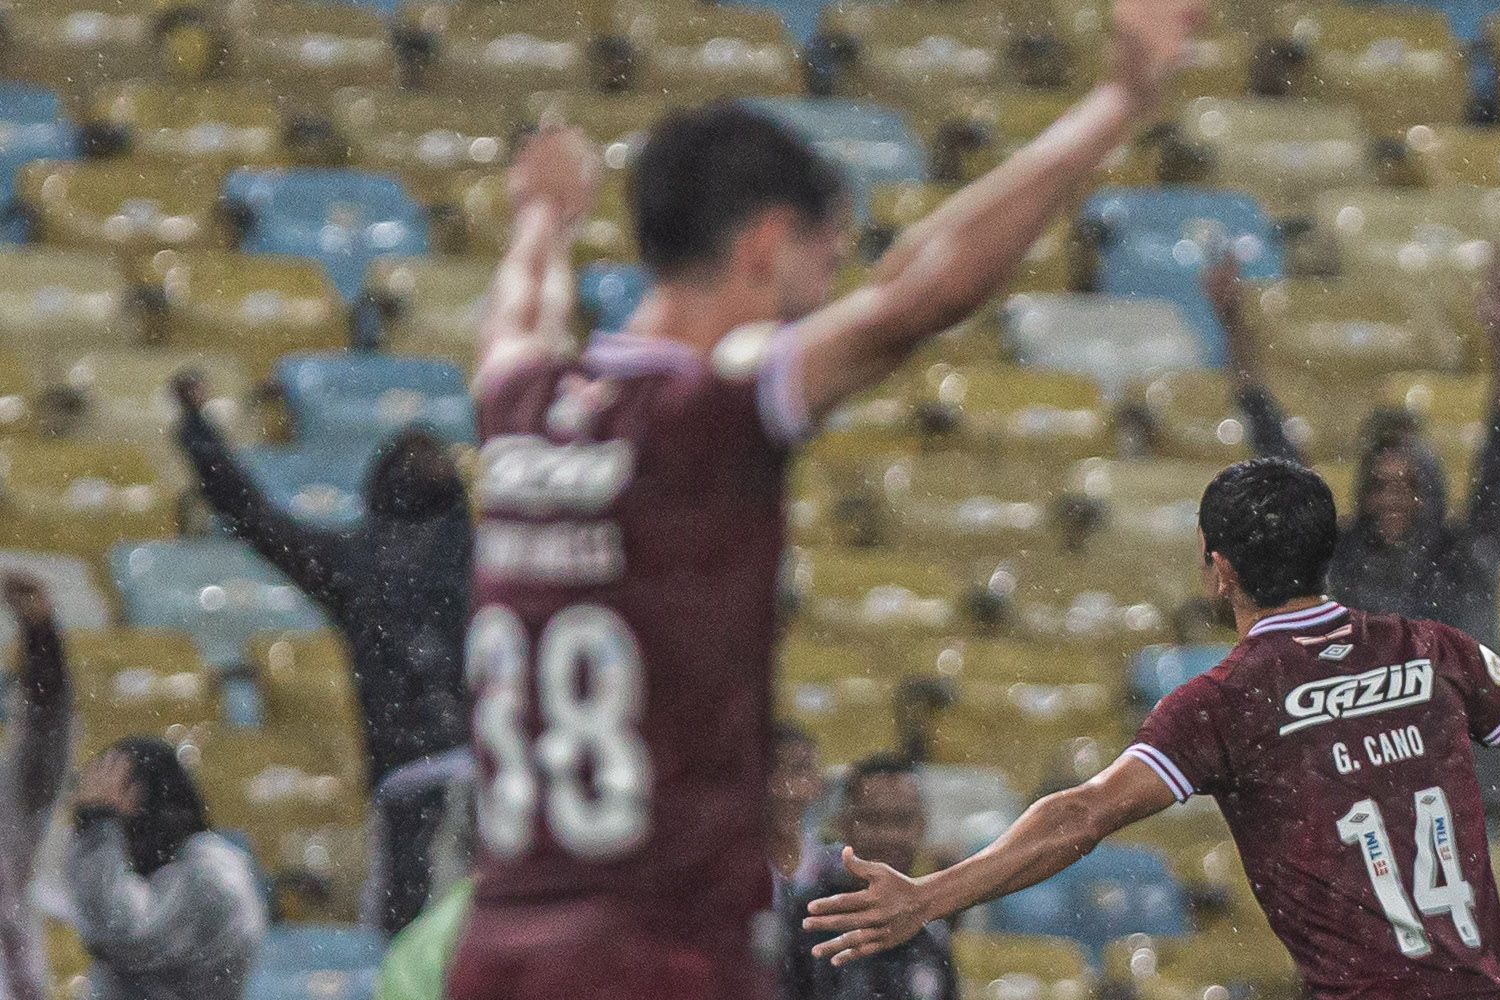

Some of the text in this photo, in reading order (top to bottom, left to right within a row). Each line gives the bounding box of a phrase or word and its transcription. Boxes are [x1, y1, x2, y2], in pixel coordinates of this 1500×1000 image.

[1282, 658, 1434, 725] GAZIN
[1333, 725, 1424, 774] G. CANO
[1337, 786, 1481, 958] 14
